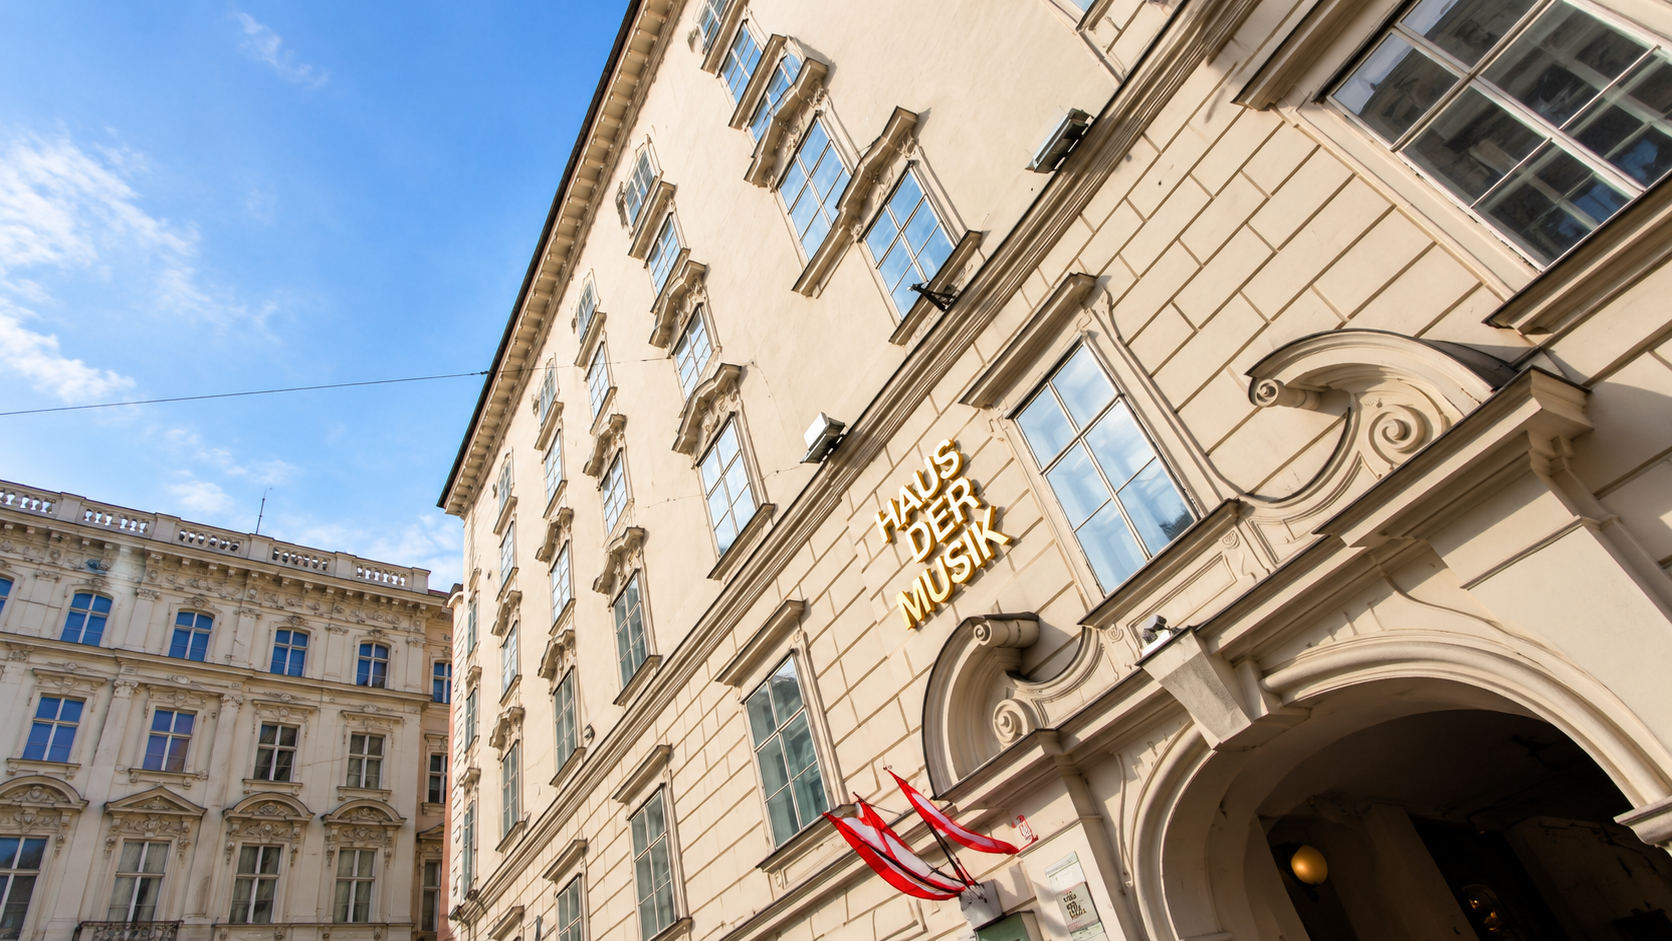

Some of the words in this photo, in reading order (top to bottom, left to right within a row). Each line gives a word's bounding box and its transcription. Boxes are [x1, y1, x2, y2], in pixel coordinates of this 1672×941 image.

[874, 438, 964, 544] HAUS
[904, 476, 982, 564] DER
[895, 505, 1012, 630] MUSIK
